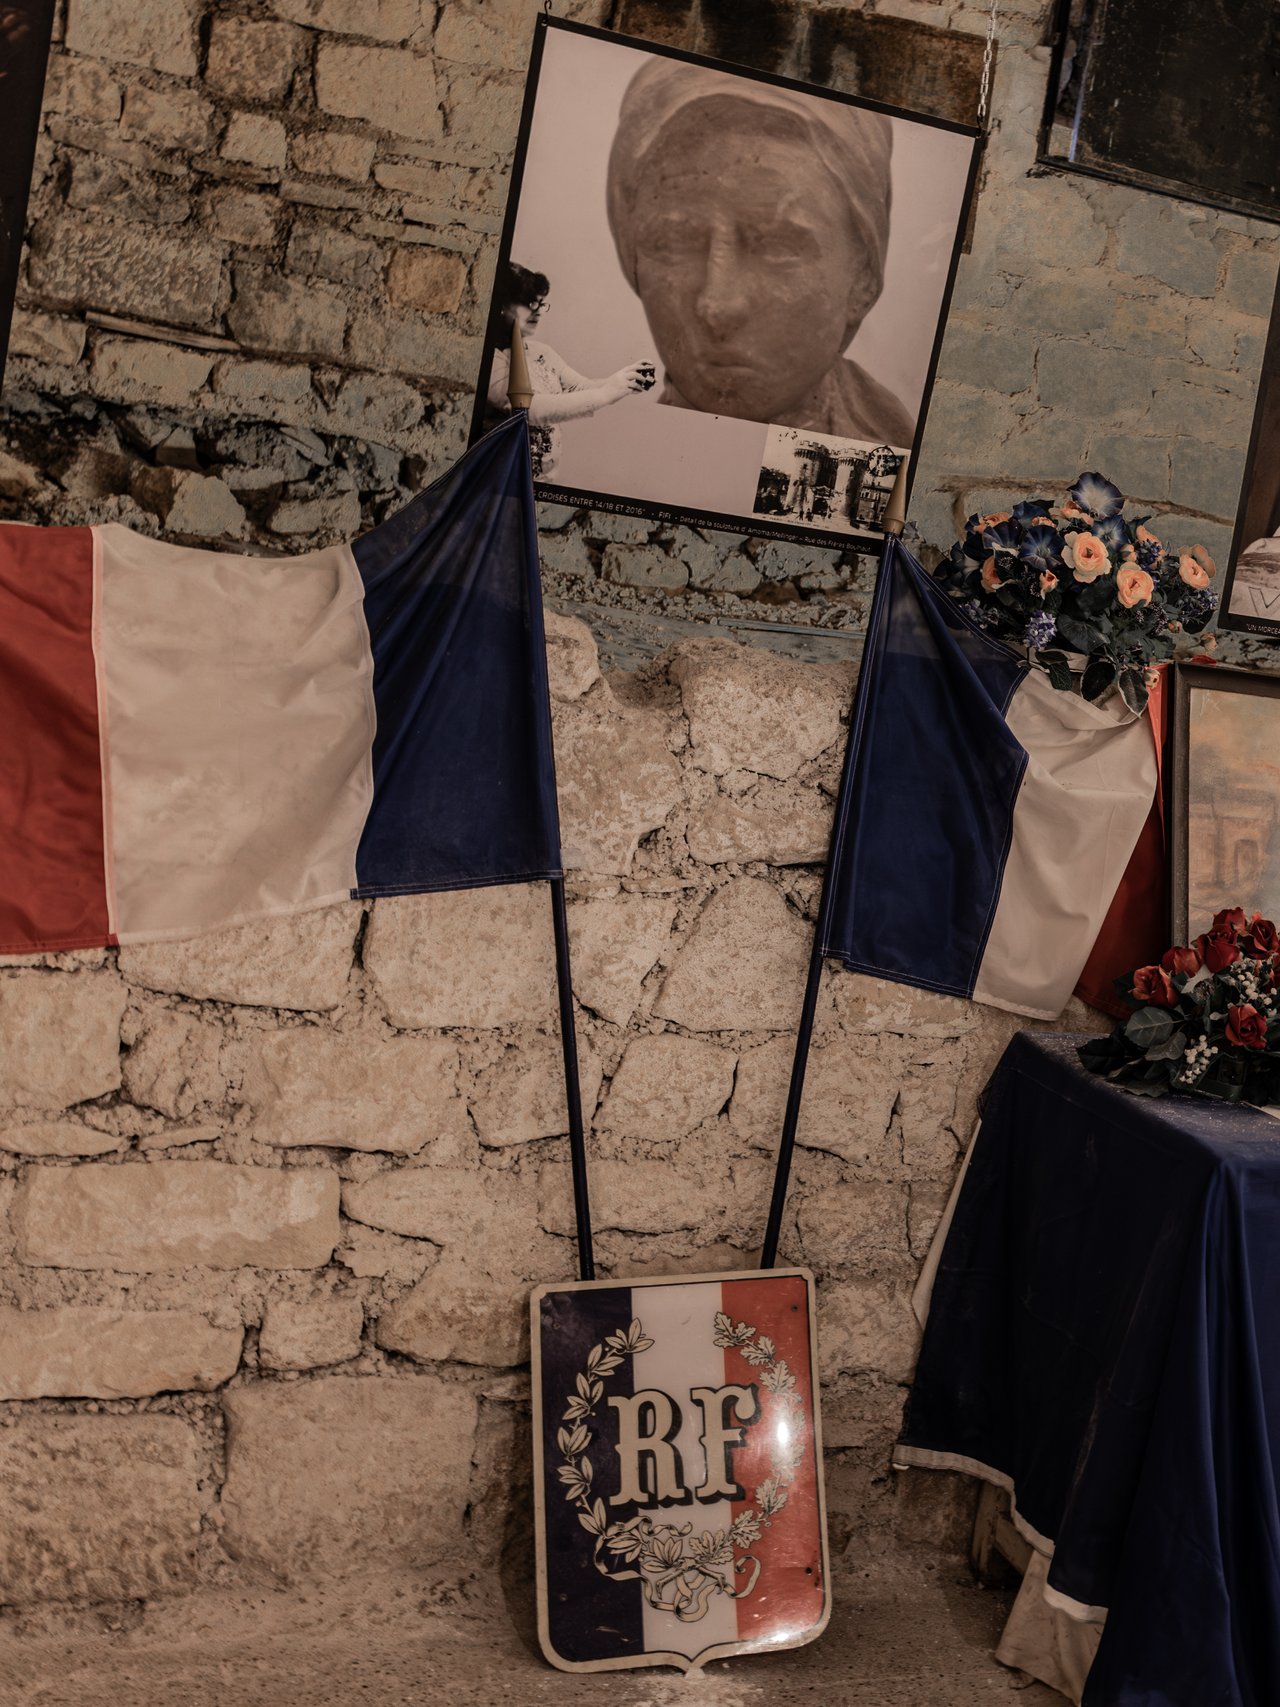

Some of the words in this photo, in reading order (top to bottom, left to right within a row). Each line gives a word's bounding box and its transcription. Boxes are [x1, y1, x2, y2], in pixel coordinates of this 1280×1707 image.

[570, 496, 593, 507] ENTRE
[595, 500, 614, 511] 14/18
[615, 504, 624, 512] ET
[804, 536, 816, 544] Rue
[607, 1382, 762, 1511] RF
